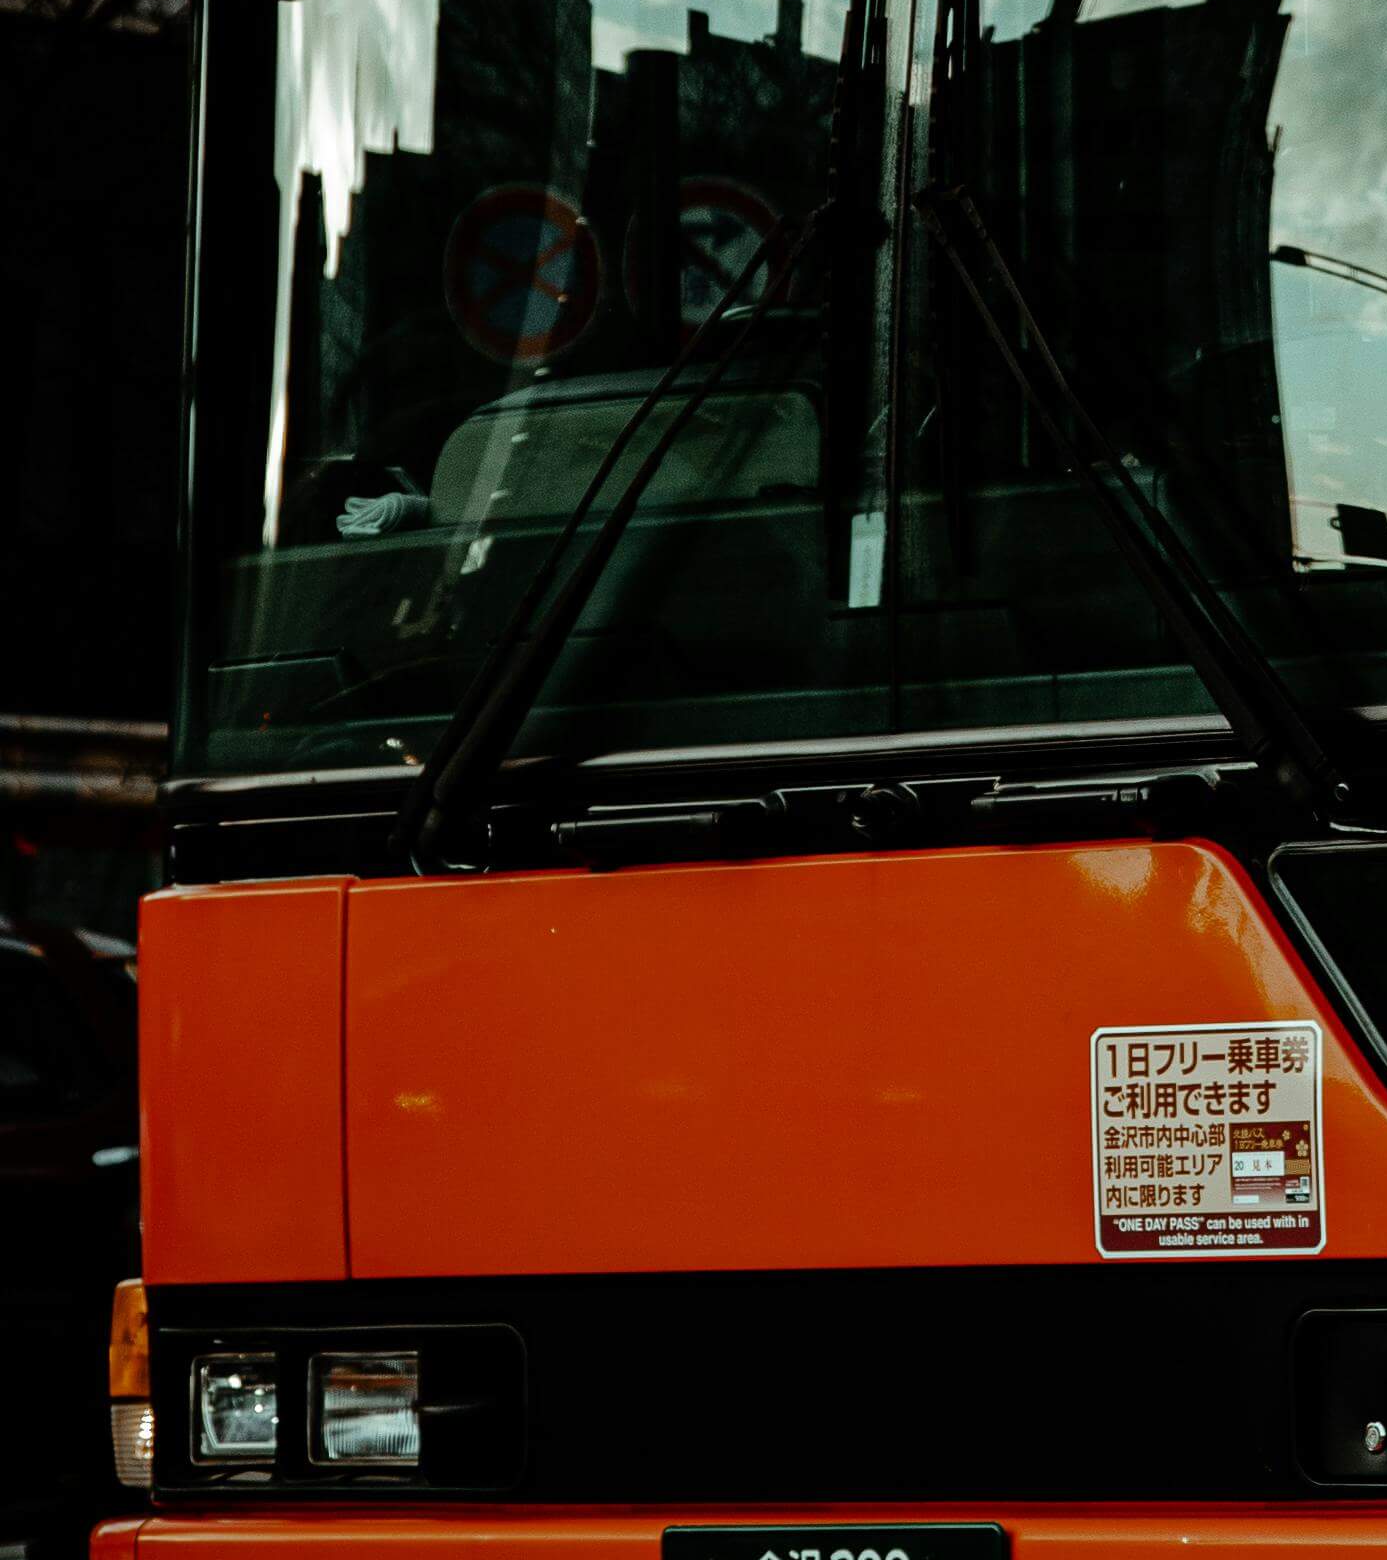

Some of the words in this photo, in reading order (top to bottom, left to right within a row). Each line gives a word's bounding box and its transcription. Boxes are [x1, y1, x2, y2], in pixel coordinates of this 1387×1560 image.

[1106, 1037, 1309, 1079] 1日フリー乗車券
[1104, 1080, 1277, 1119] ご利用できます
[1104, 1123, 1226, 1149] 金沢市内中心部
[1104, 1153, 1223, 1179] 利用可能エリア
[1106, 1183, 1205, 1209] 内に限ります
[1145, 1217, 1168, 1231] DAY
[1206, 1218, 1226, 1230] can
[1228, 1216, 1242, 1229] be
[1244, 1216, 1271, 1229] used
[1273, 1215, 1296, 1229] with
[1298, 1214, 1310, 1228] in
[1159, 1232, 1194, 1246] usable
[1196, 1231, 1235, 1245] service
[1236, 1232, 1264, 1245] area.
